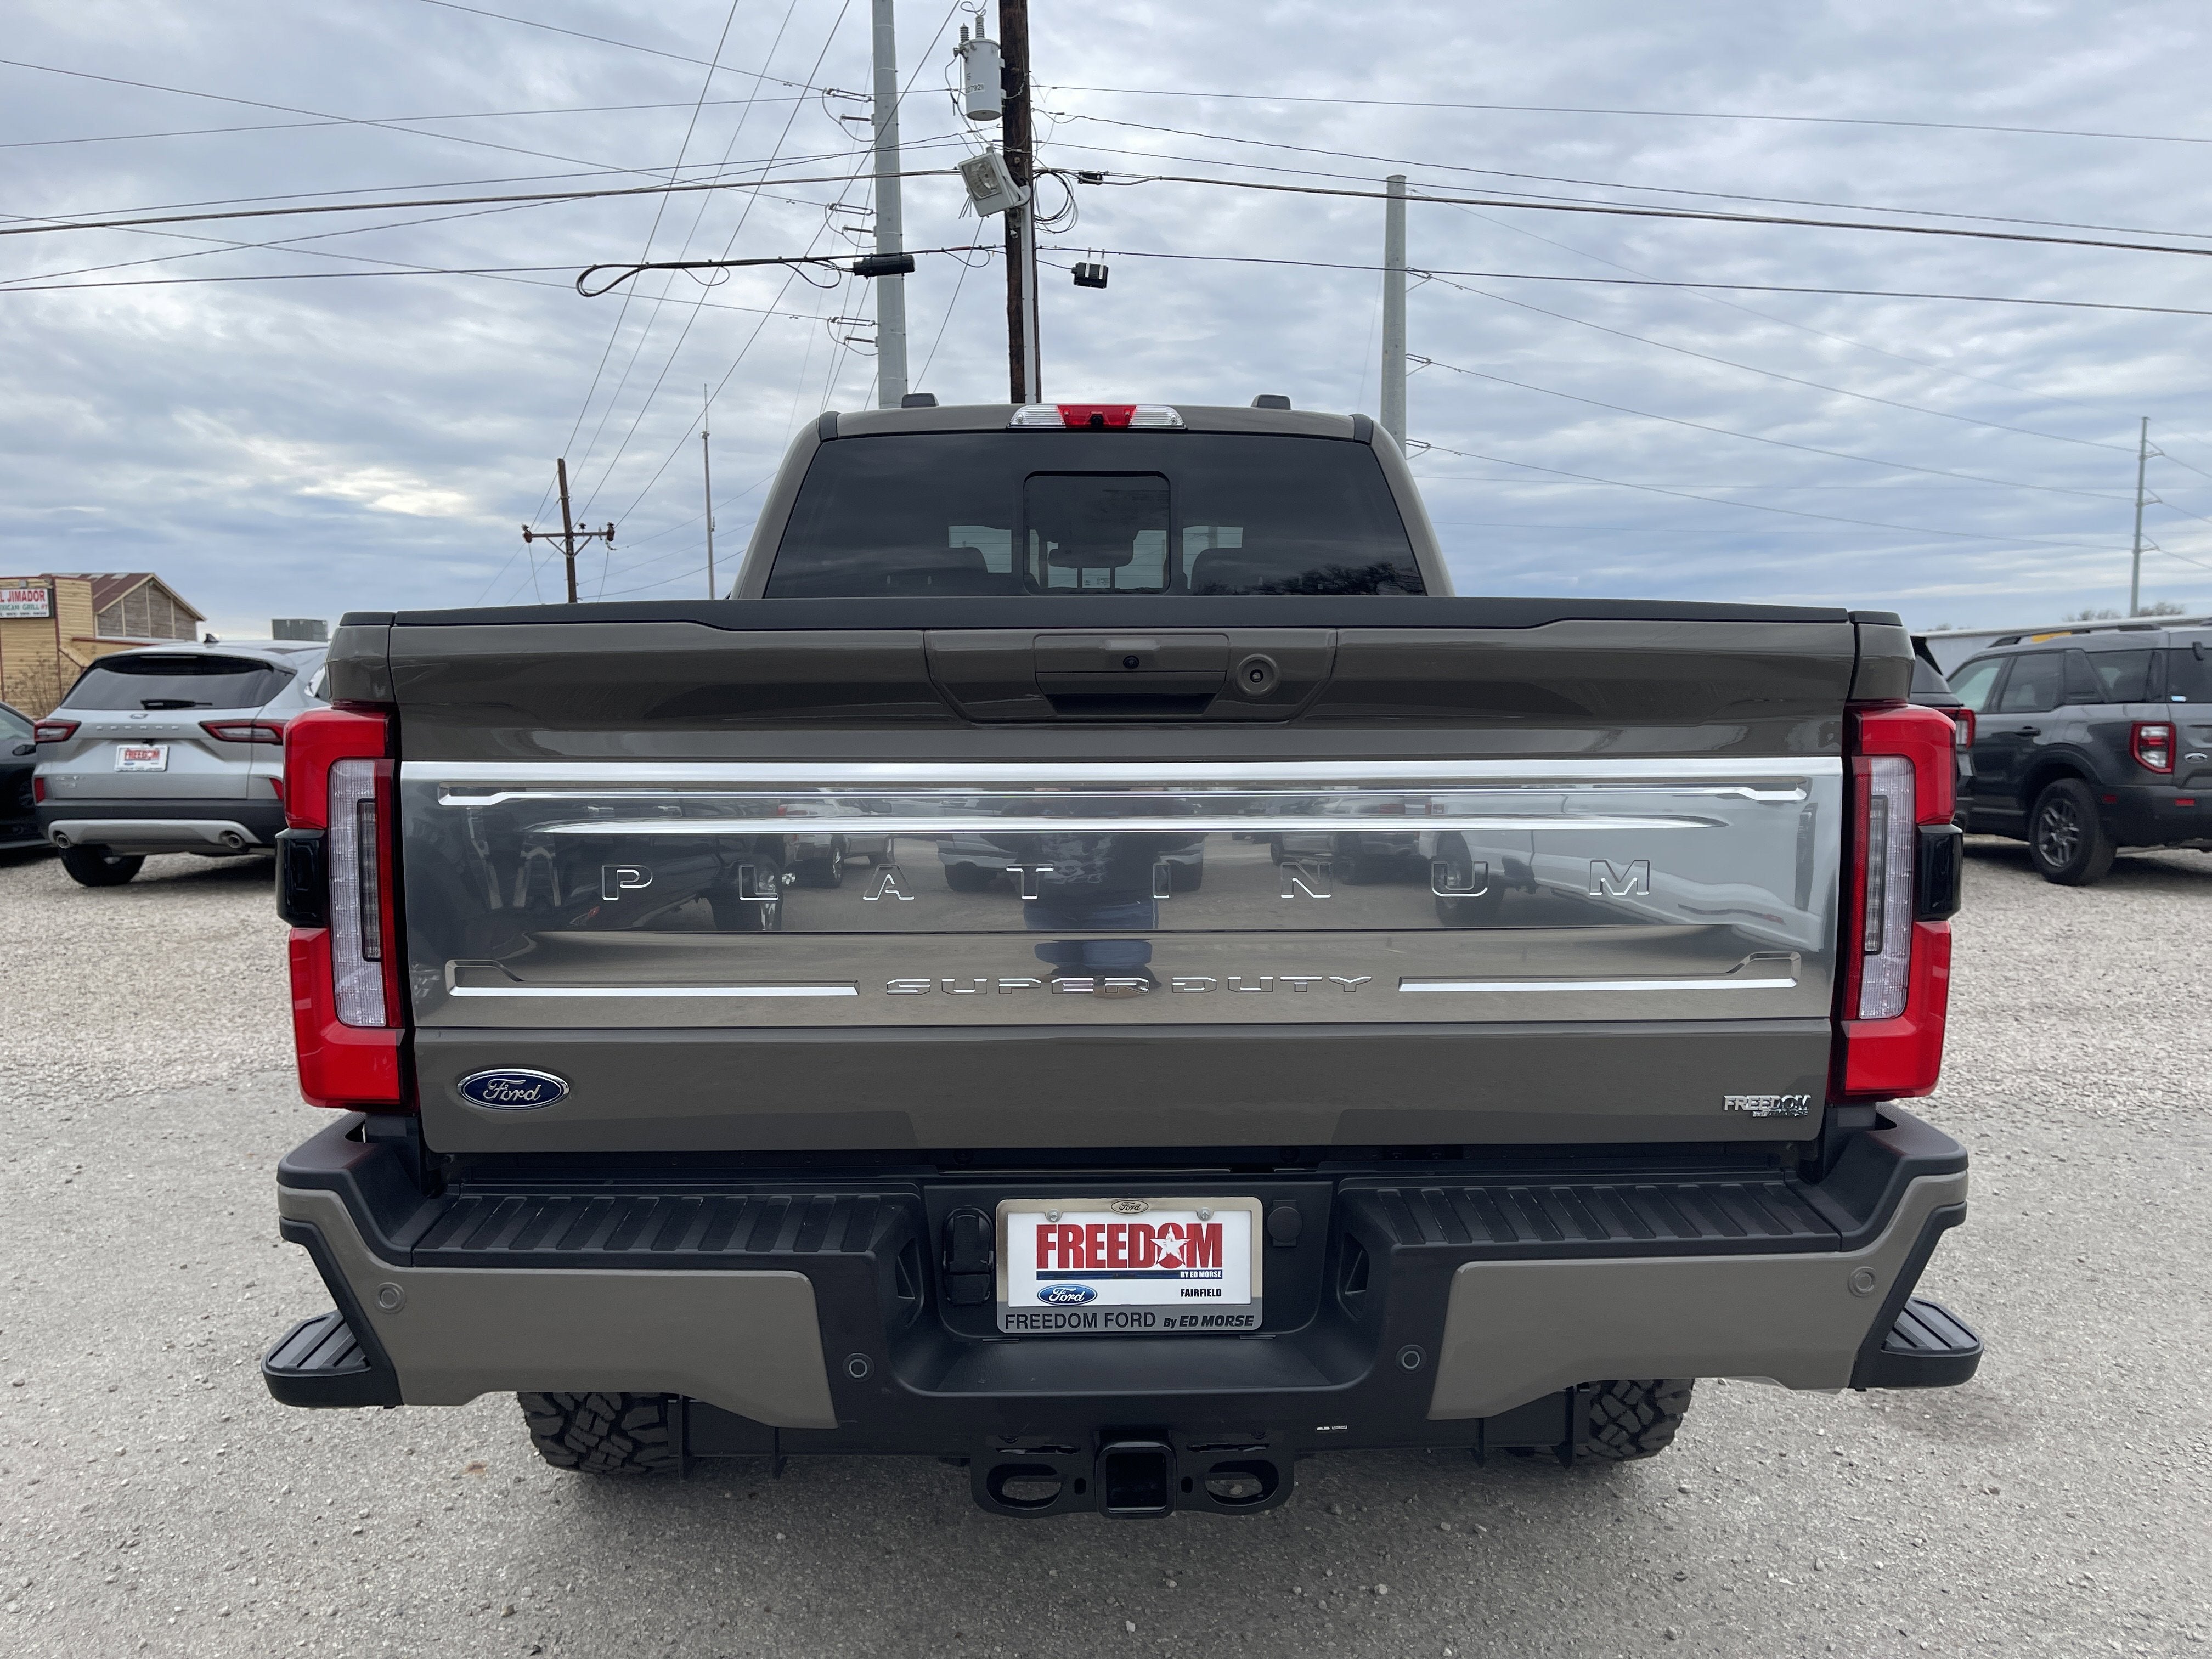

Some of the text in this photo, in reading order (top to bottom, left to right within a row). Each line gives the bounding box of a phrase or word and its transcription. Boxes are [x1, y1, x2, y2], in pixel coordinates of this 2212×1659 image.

[7, 590, 46, 602] JIMADOR
[601, 859, 1650, 901] PLATINUM
[887, 976, 1372, 995] SUPER DUTY
[483, 1079, 541, 1101] Ford
[1724, 1095, 1811, 1111] FREEDOM
[1119, 1201, 1141, 1211] Ford
[1036, 1223, 1223, 1269] FREEDOM
[1049, 1286, 1085, 1302] Ford
[1181, 1288, 1222, 1297] FAIRFIELD
[1005, 1312, 1255, 1329] FREEDOM FORD By ED MORSE
